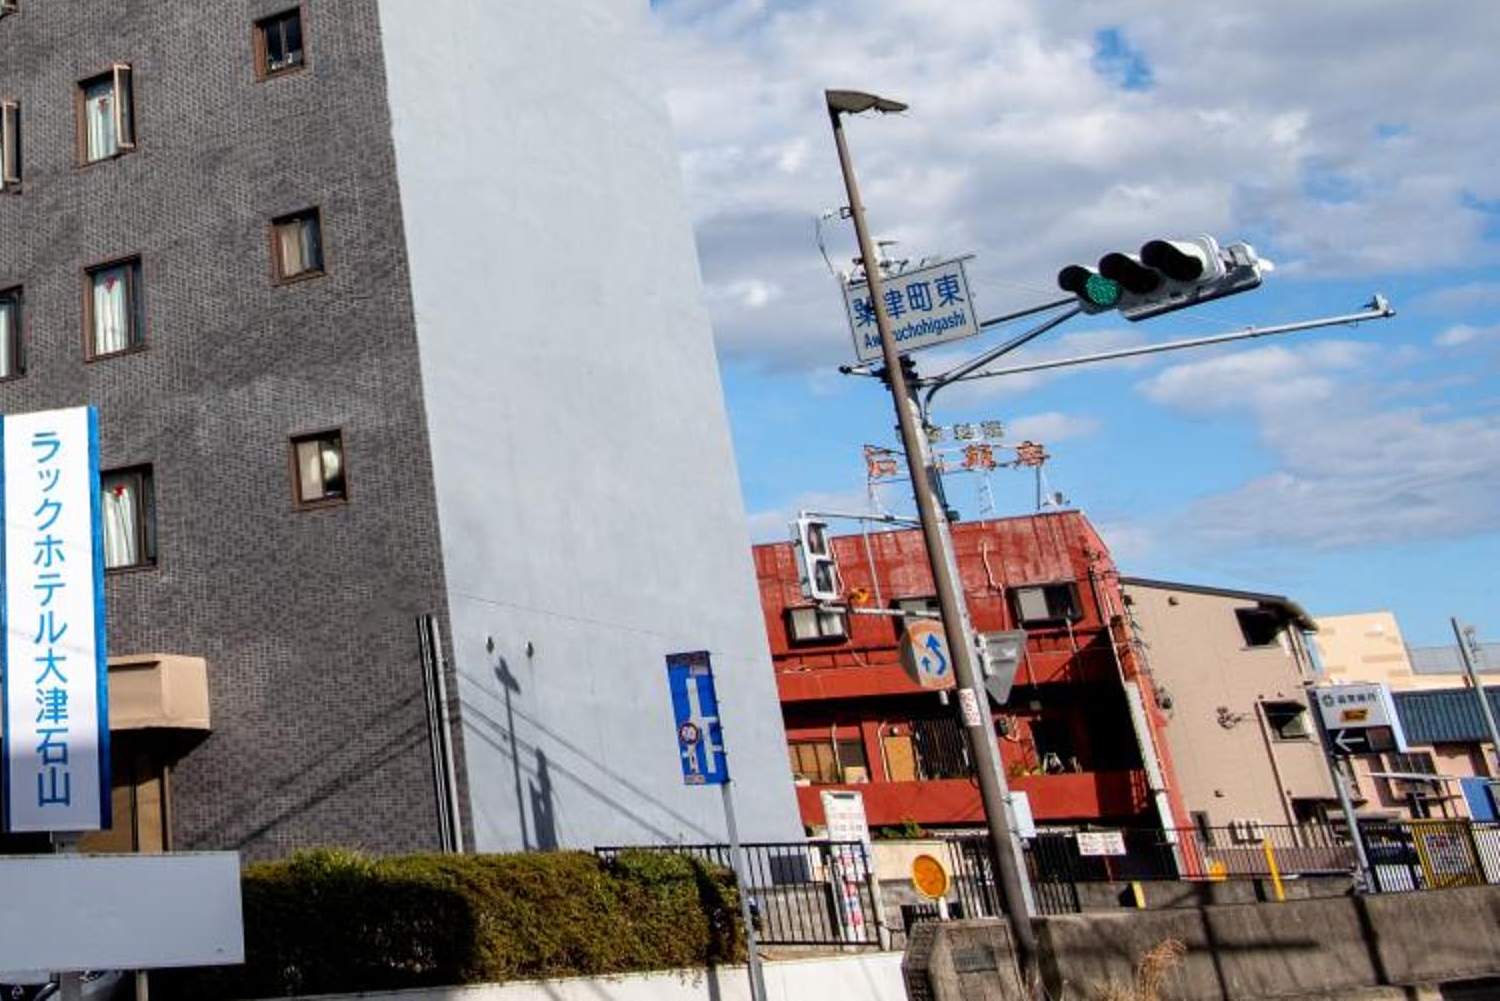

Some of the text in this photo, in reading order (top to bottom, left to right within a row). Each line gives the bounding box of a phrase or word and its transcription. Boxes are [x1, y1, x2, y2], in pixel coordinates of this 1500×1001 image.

[30, 430, 71, 808] ラックホテル大津石山
